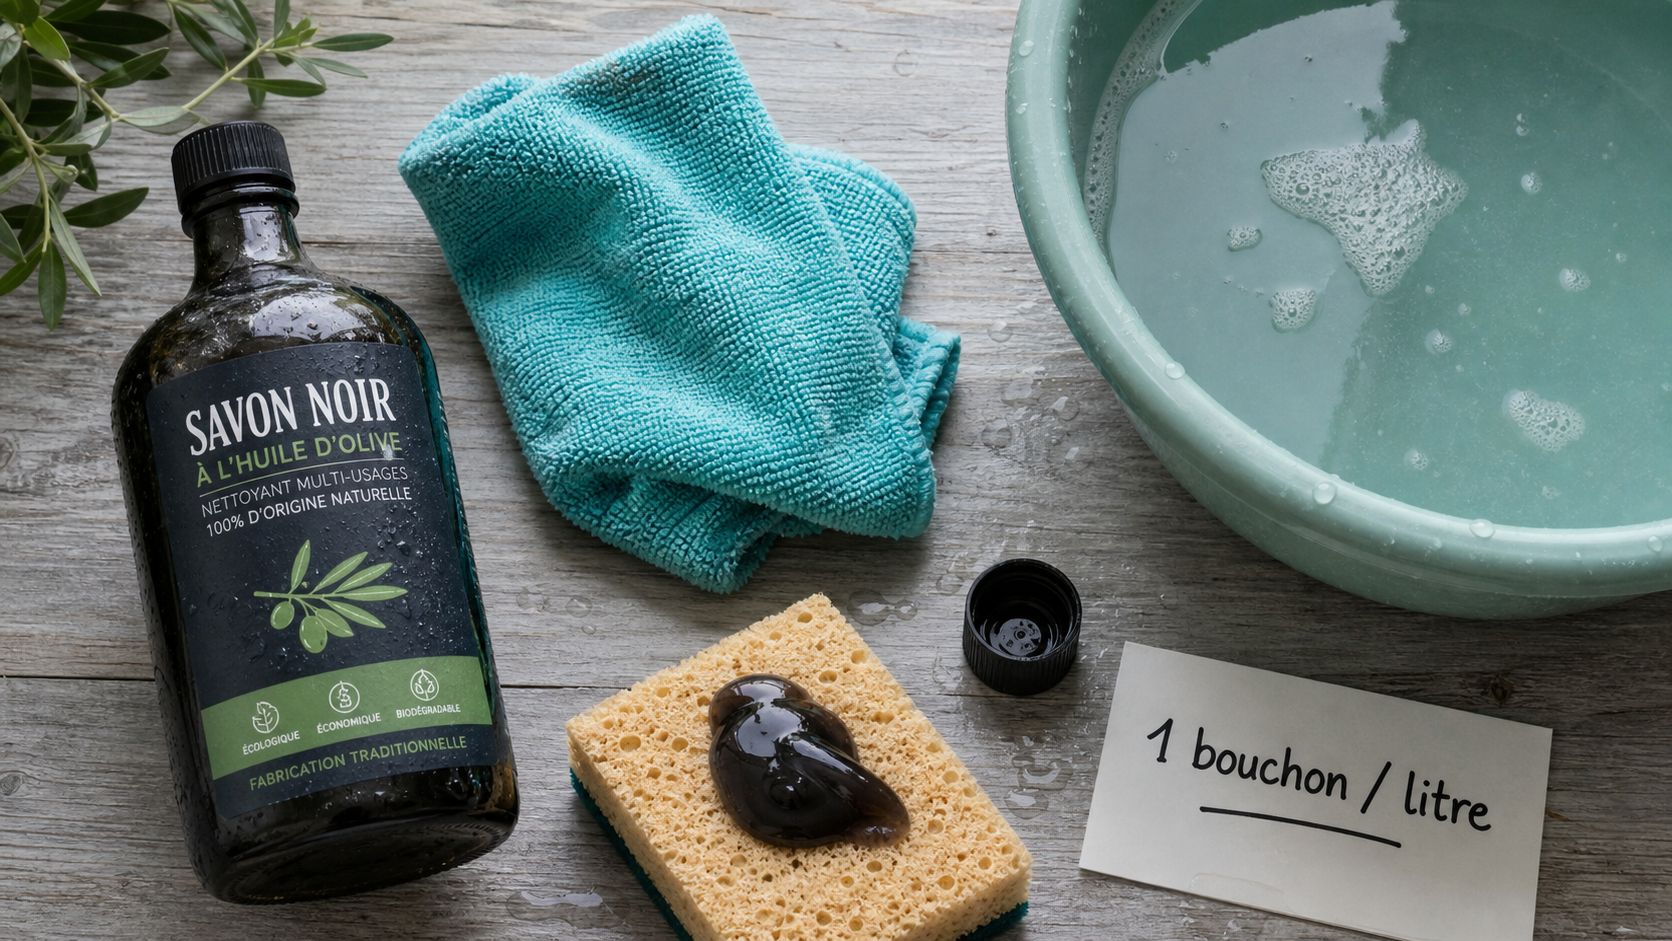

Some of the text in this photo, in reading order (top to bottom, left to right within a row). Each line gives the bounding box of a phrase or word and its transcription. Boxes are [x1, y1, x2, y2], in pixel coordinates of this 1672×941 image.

[185, 378, 397, 456] SAVON NOIR
[197, 432, 403, 488] À L'HUILE D'OLIVE
[201, 466, 409, 518] NETTOYANT MULTI-USAGES
[206, 486, 413, 538] 100% D'ORIGINE NATURELLE
[242, 730, 301, 756] ÉCOLOGIQUE
[316, 712, 382, 734] ÉCONOMIQUE
[249, 735, 468, 791] FABRICATION TRADITIONNELLE
[1146, 718, 1492, 832] 1 bouchon / litre
